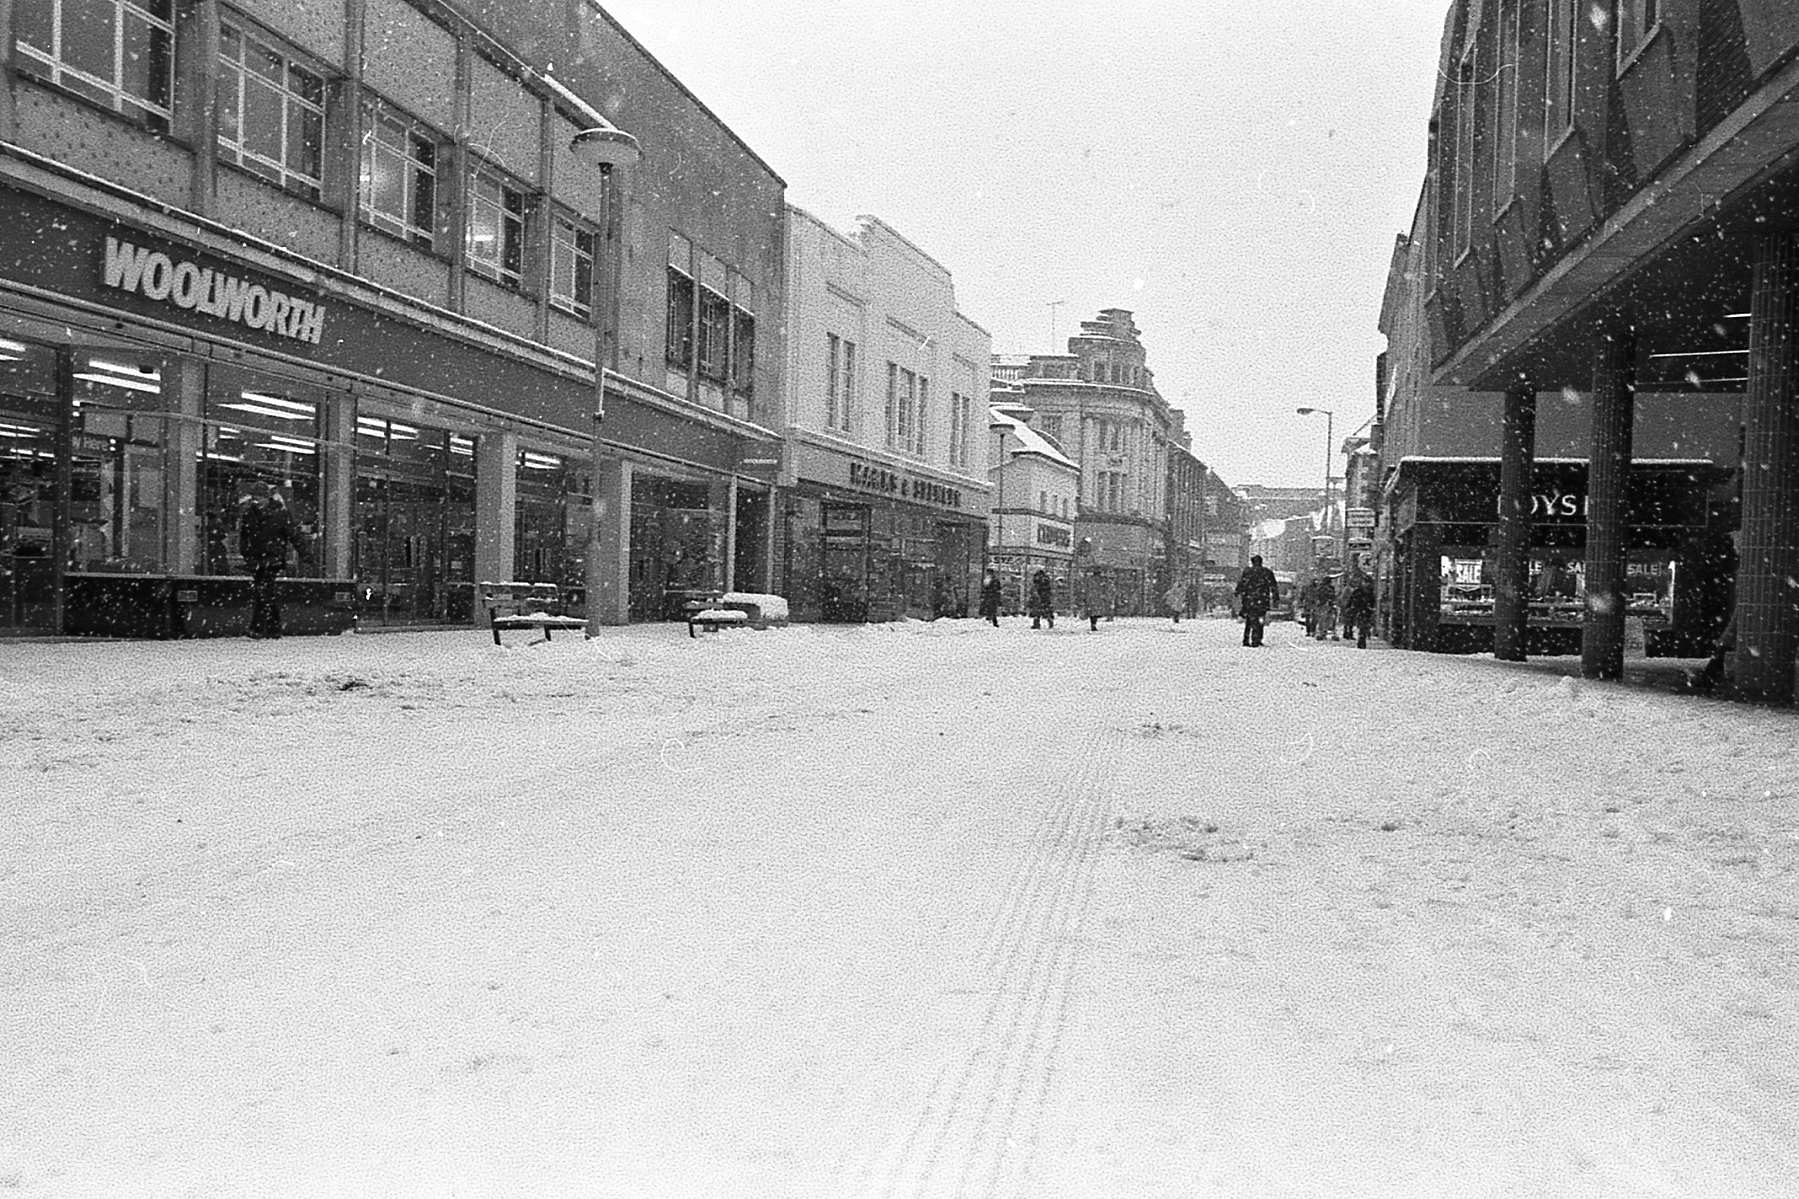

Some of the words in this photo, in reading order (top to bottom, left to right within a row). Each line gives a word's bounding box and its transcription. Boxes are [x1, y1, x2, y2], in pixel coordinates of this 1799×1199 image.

[104, 236, 326, 344] WOOLWORTH
[1456, 564, 1481, 584] SALE
[1626, 562, 1658, 576] SALE
